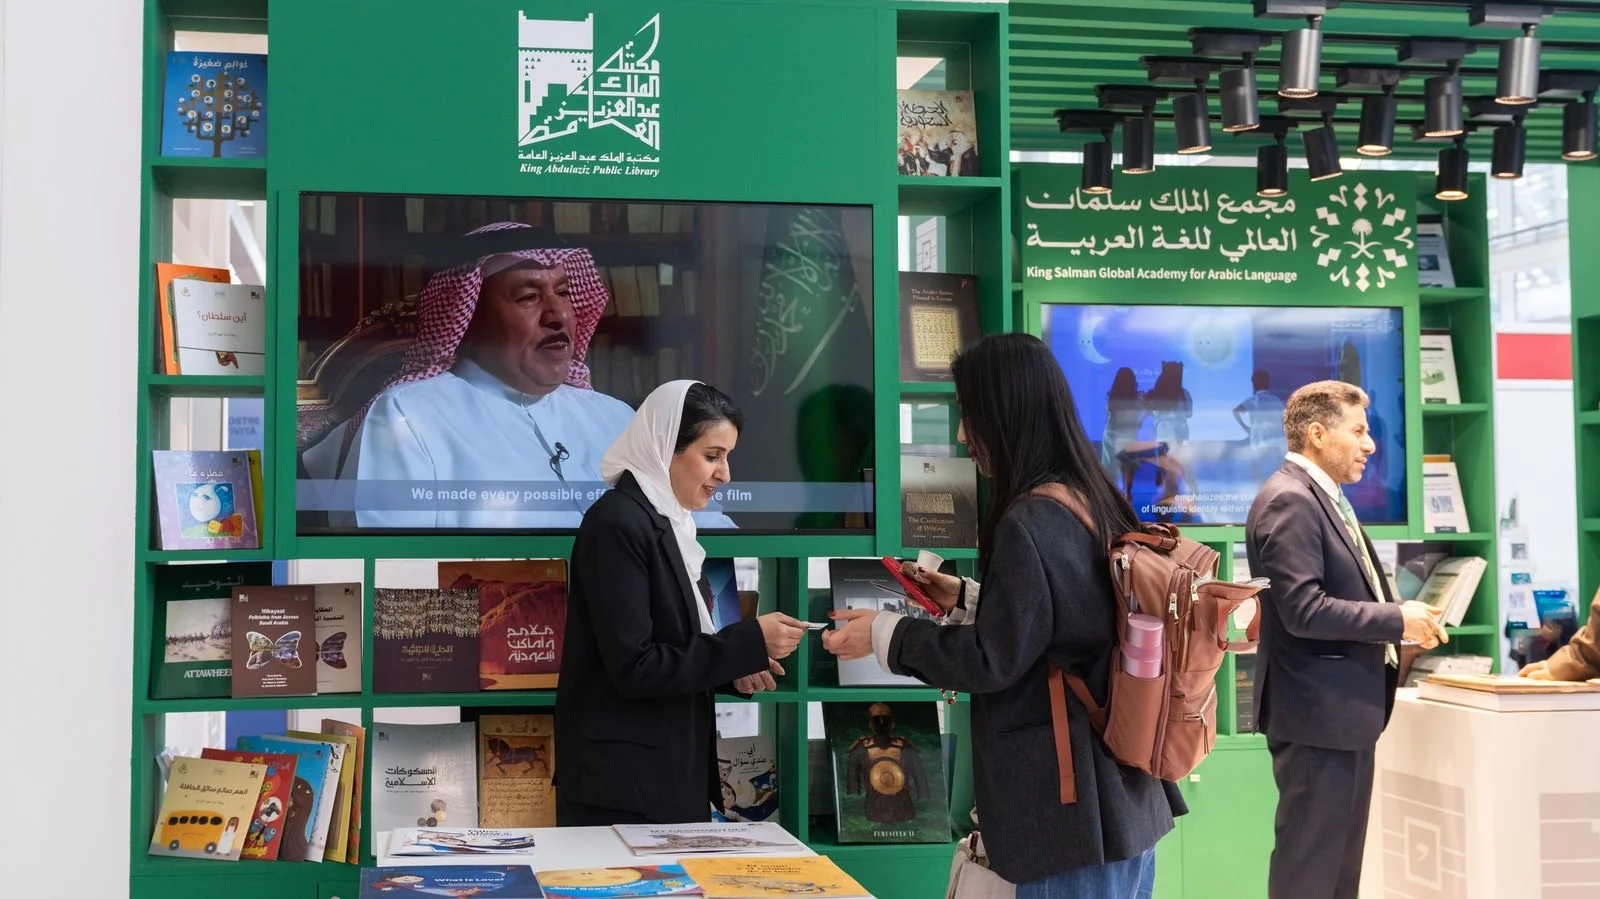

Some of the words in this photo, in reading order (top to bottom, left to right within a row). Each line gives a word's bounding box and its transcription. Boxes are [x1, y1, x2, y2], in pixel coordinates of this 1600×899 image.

[518, 150, 548, 160] العامة
[549, 151, 577, 162] العزيز
[579, 153, 597, 164] عبد
[599, 152, 624, 164] الملك
[626, 152, 660, 165] مكتبة
[520, 163, 543, 174] King
[545, 164, 591, 175] Abdulaziz
[593, 165, 623, 175] Public
[625, 166, 660, 178] Library
[1025, 187, 1142, 211] سلمان
[1150, 188, 1210, 215] الملك
[1217, 192, 1297, 224] مجمع
[1026, 223, 1144, 257] العربية
[1151, 224, 1212, 250] للغة
[1219, 226, 1297, 263] العالمي
[1027, 266, 1052, 280] King
[1054, 266, 1097, 279] Salman
[1099, 267, 1135, 279] Global
[1137, 267, 1188, 282] Academy
[1190, 268, 1206, 280] for
[1208, 268, 1242, 281] Arabic
[1245, 269, 1297, 284] Language
[232, 311, 247, 323] أين
[411, 487, 434, 500] We
[437, 487, 478, 500] made
[481, 490, 519, 503] every
[523, 487, 583, 503] possible
[587, 488, 607, 501] eff
[727, 488, 752, 501] film
[1174, 493, 1224, 502] emphasizes
[1141, 504, 1150, 514] of
[1152, 504, 1188, 515] linguistic
[1189, 504, 1218, 515] identity
[1220, 505, 1244, 513] within
[182, 573, 245, 591] التوحيد
[507, 624, 554, 639] ملامح
[384, 766, 437, 777] المسكوكات
